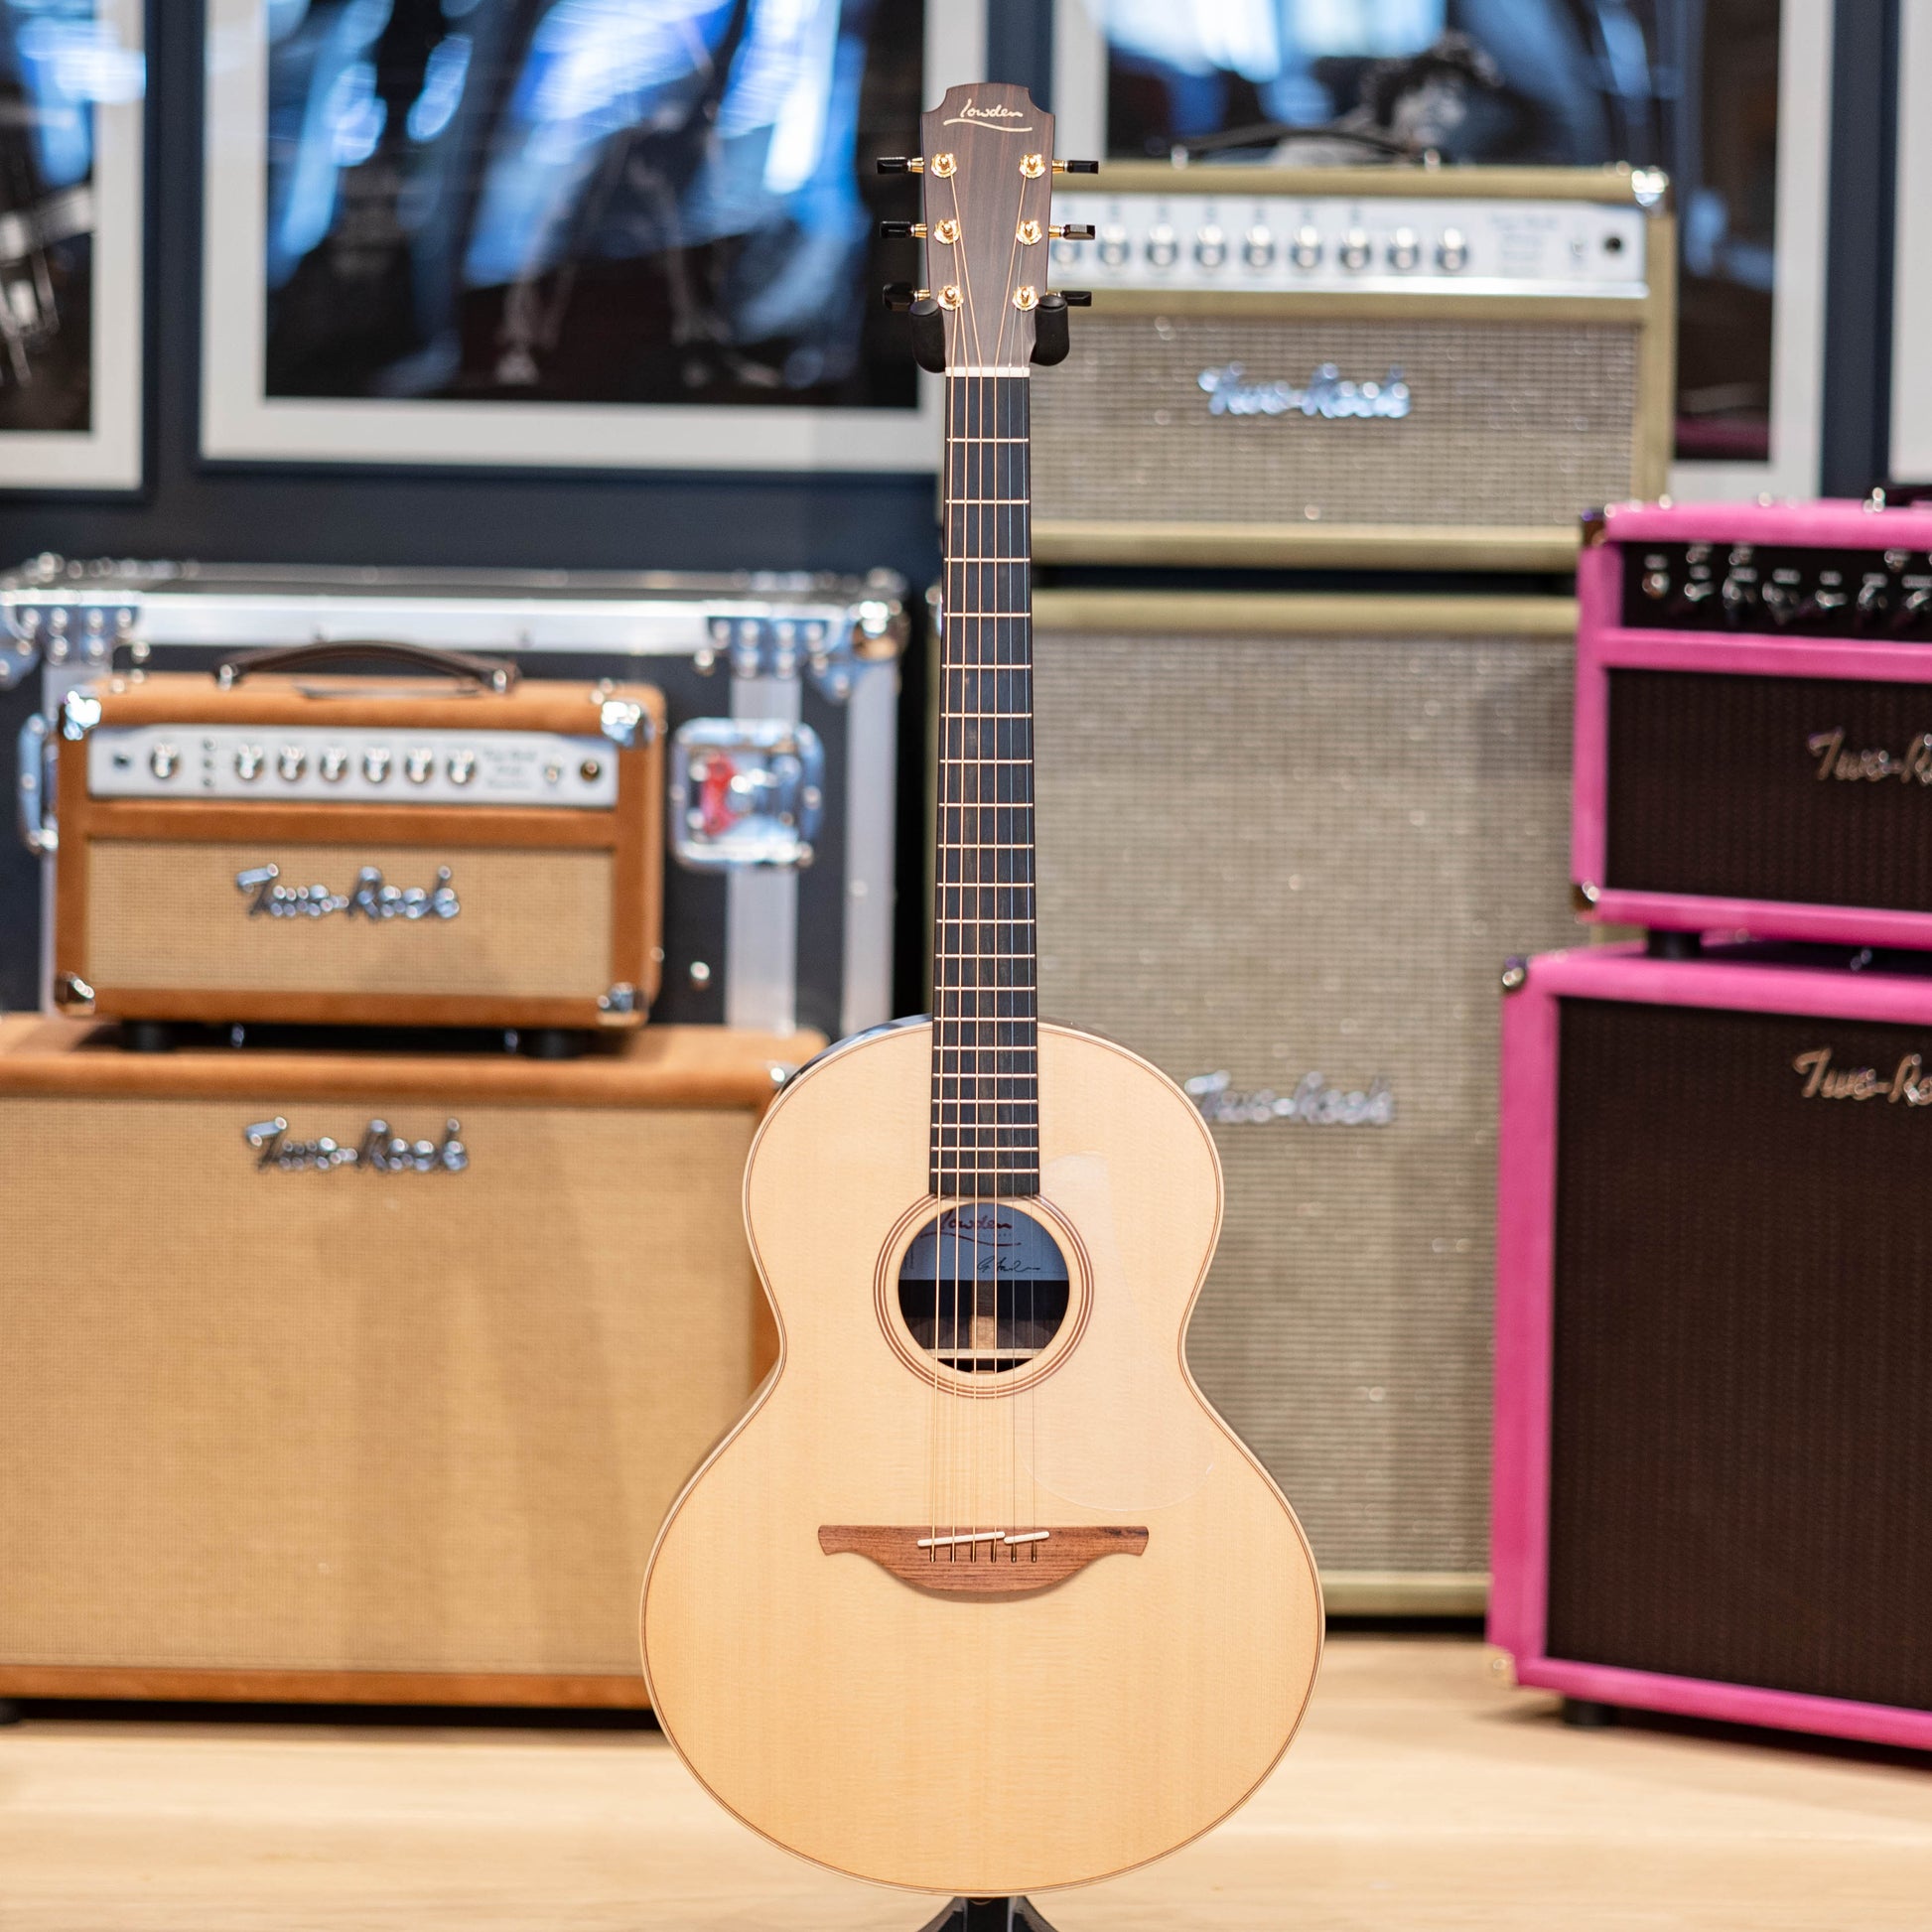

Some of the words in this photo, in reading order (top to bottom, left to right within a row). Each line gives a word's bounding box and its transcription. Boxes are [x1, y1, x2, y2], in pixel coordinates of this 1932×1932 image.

[1808, 727, 1932, 782] Two-R
[236, 862, 460, 923] Two-Rock
[245, 1116, 468, 1172] Two-Rock
